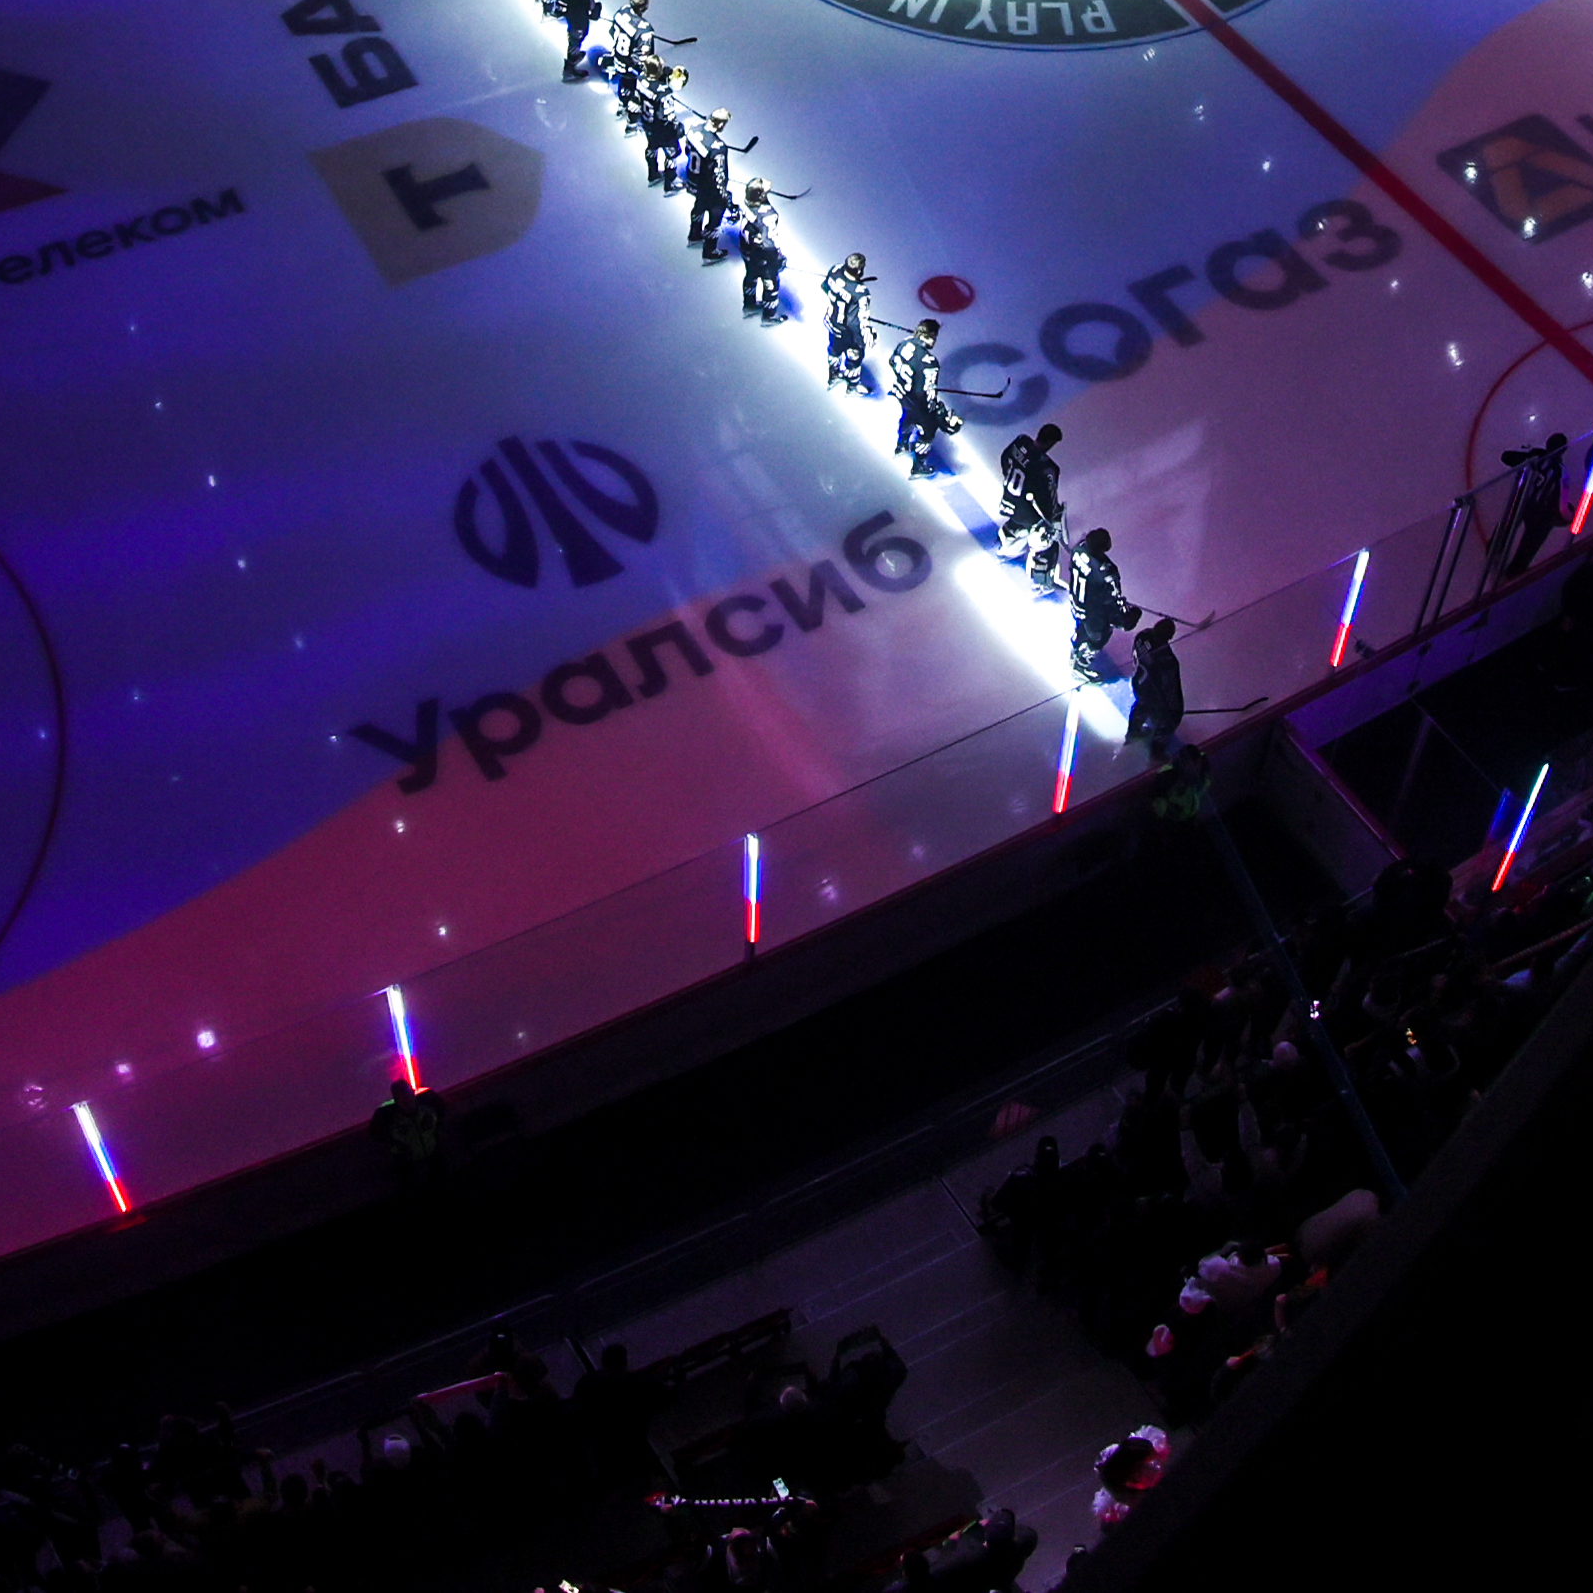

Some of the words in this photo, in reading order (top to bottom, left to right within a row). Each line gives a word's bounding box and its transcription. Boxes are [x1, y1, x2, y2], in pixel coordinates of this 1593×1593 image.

[379, 162, 491, 233] Т
[936, 196, 1404, 429] согаз
[347, 508, 933, 796] Уралсиб
